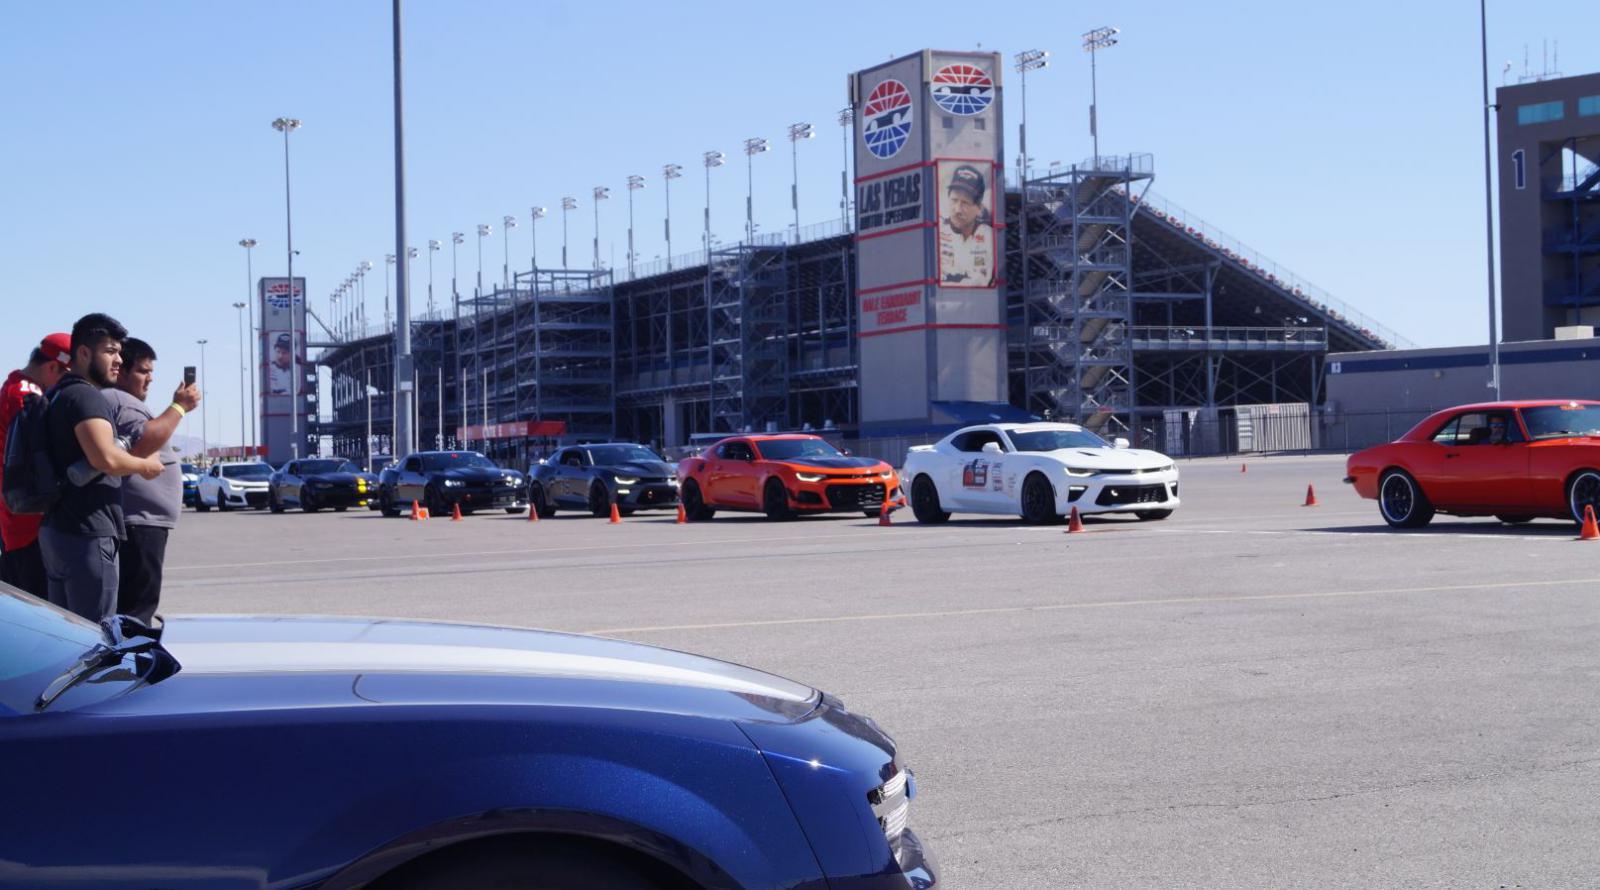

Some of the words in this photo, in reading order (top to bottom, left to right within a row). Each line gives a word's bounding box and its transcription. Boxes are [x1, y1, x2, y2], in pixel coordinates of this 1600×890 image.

[1512, 149, 1526, 190] 1
[859, 183, 881, 214] LAS
[883, 173, 921, 208] VEGAS
